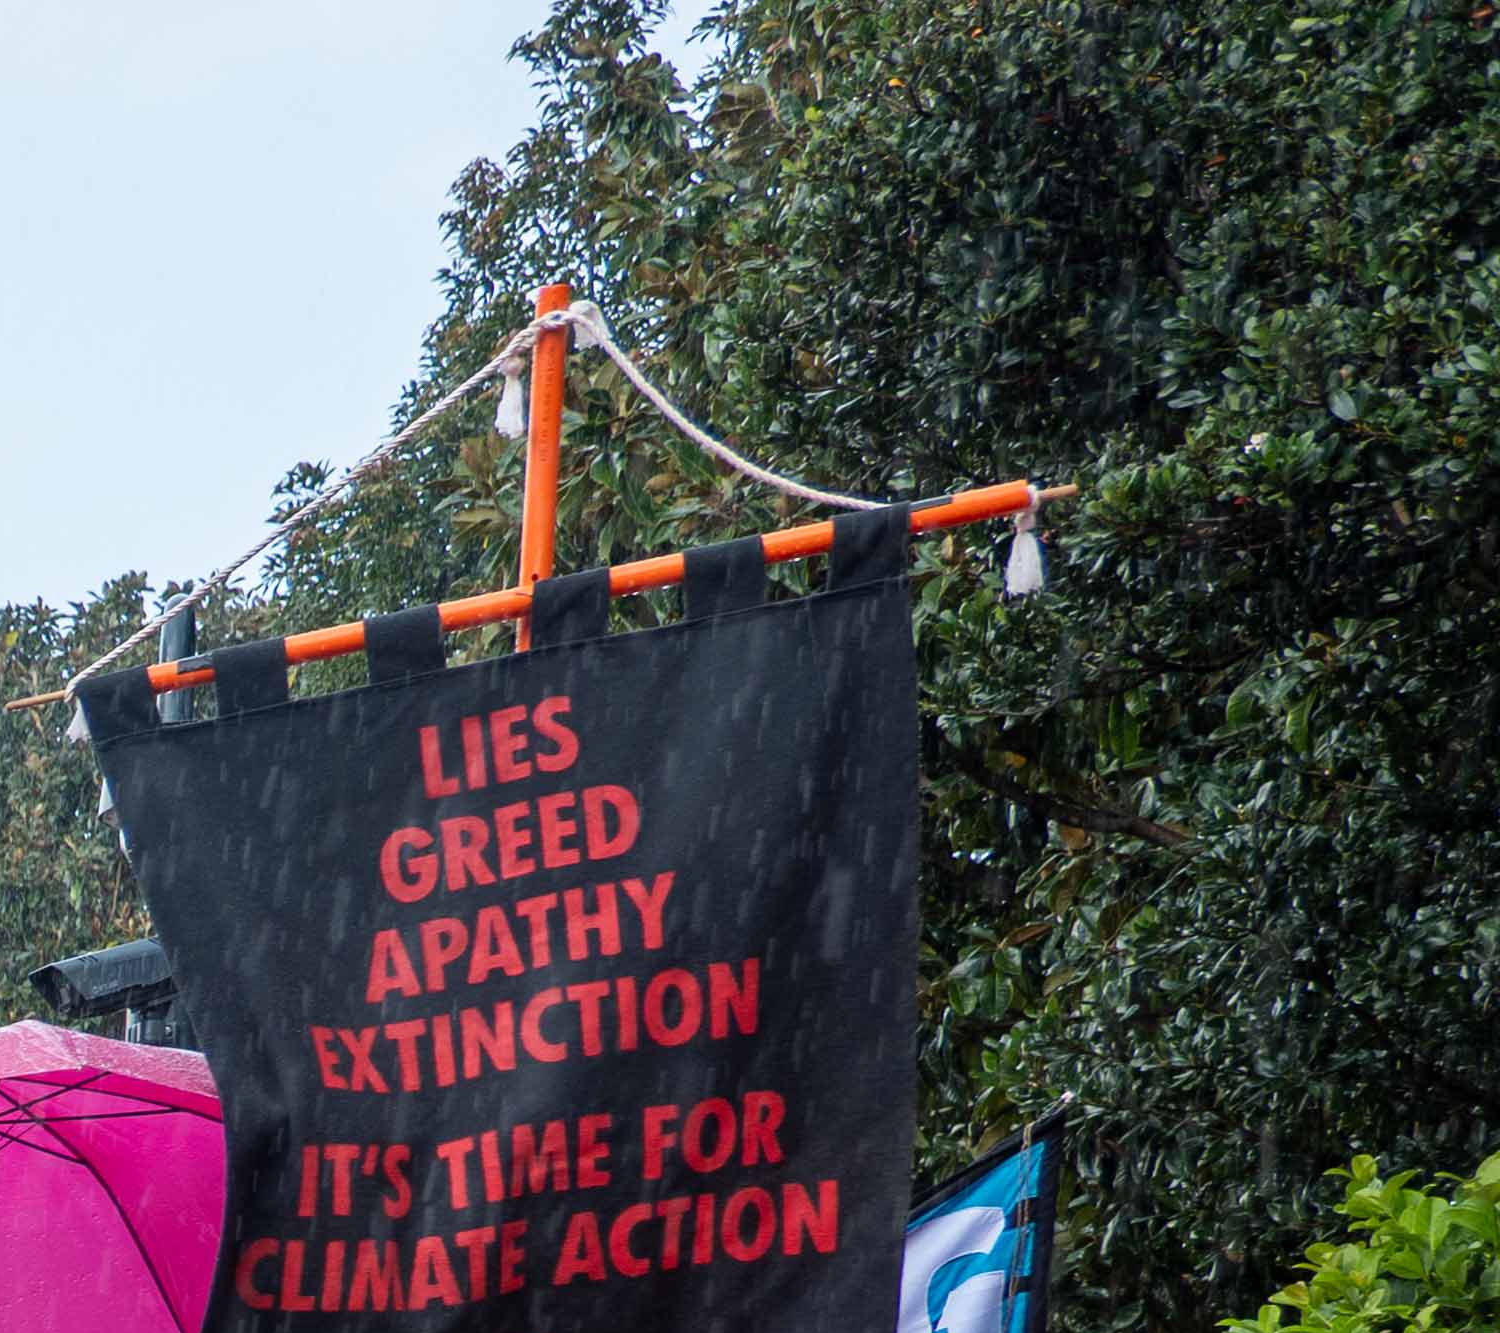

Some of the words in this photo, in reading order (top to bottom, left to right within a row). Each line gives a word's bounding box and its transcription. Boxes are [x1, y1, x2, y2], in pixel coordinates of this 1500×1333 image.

[419, 695, 578, 800] LIES
[380, 784, 641, 904] GREED
[365, 871, 675, 1003] APATHY
[311, 957, 761, 1093] EXTINCTION
[298, 1144, 411, 1219] IT'S
[438, 1112, 614, 1210] TIME
[643, 1090, 784, 1181] FOR
[236, 1222, 527, 1312] CLIMATE
[553, 1179, 838, 1286] ACTION
